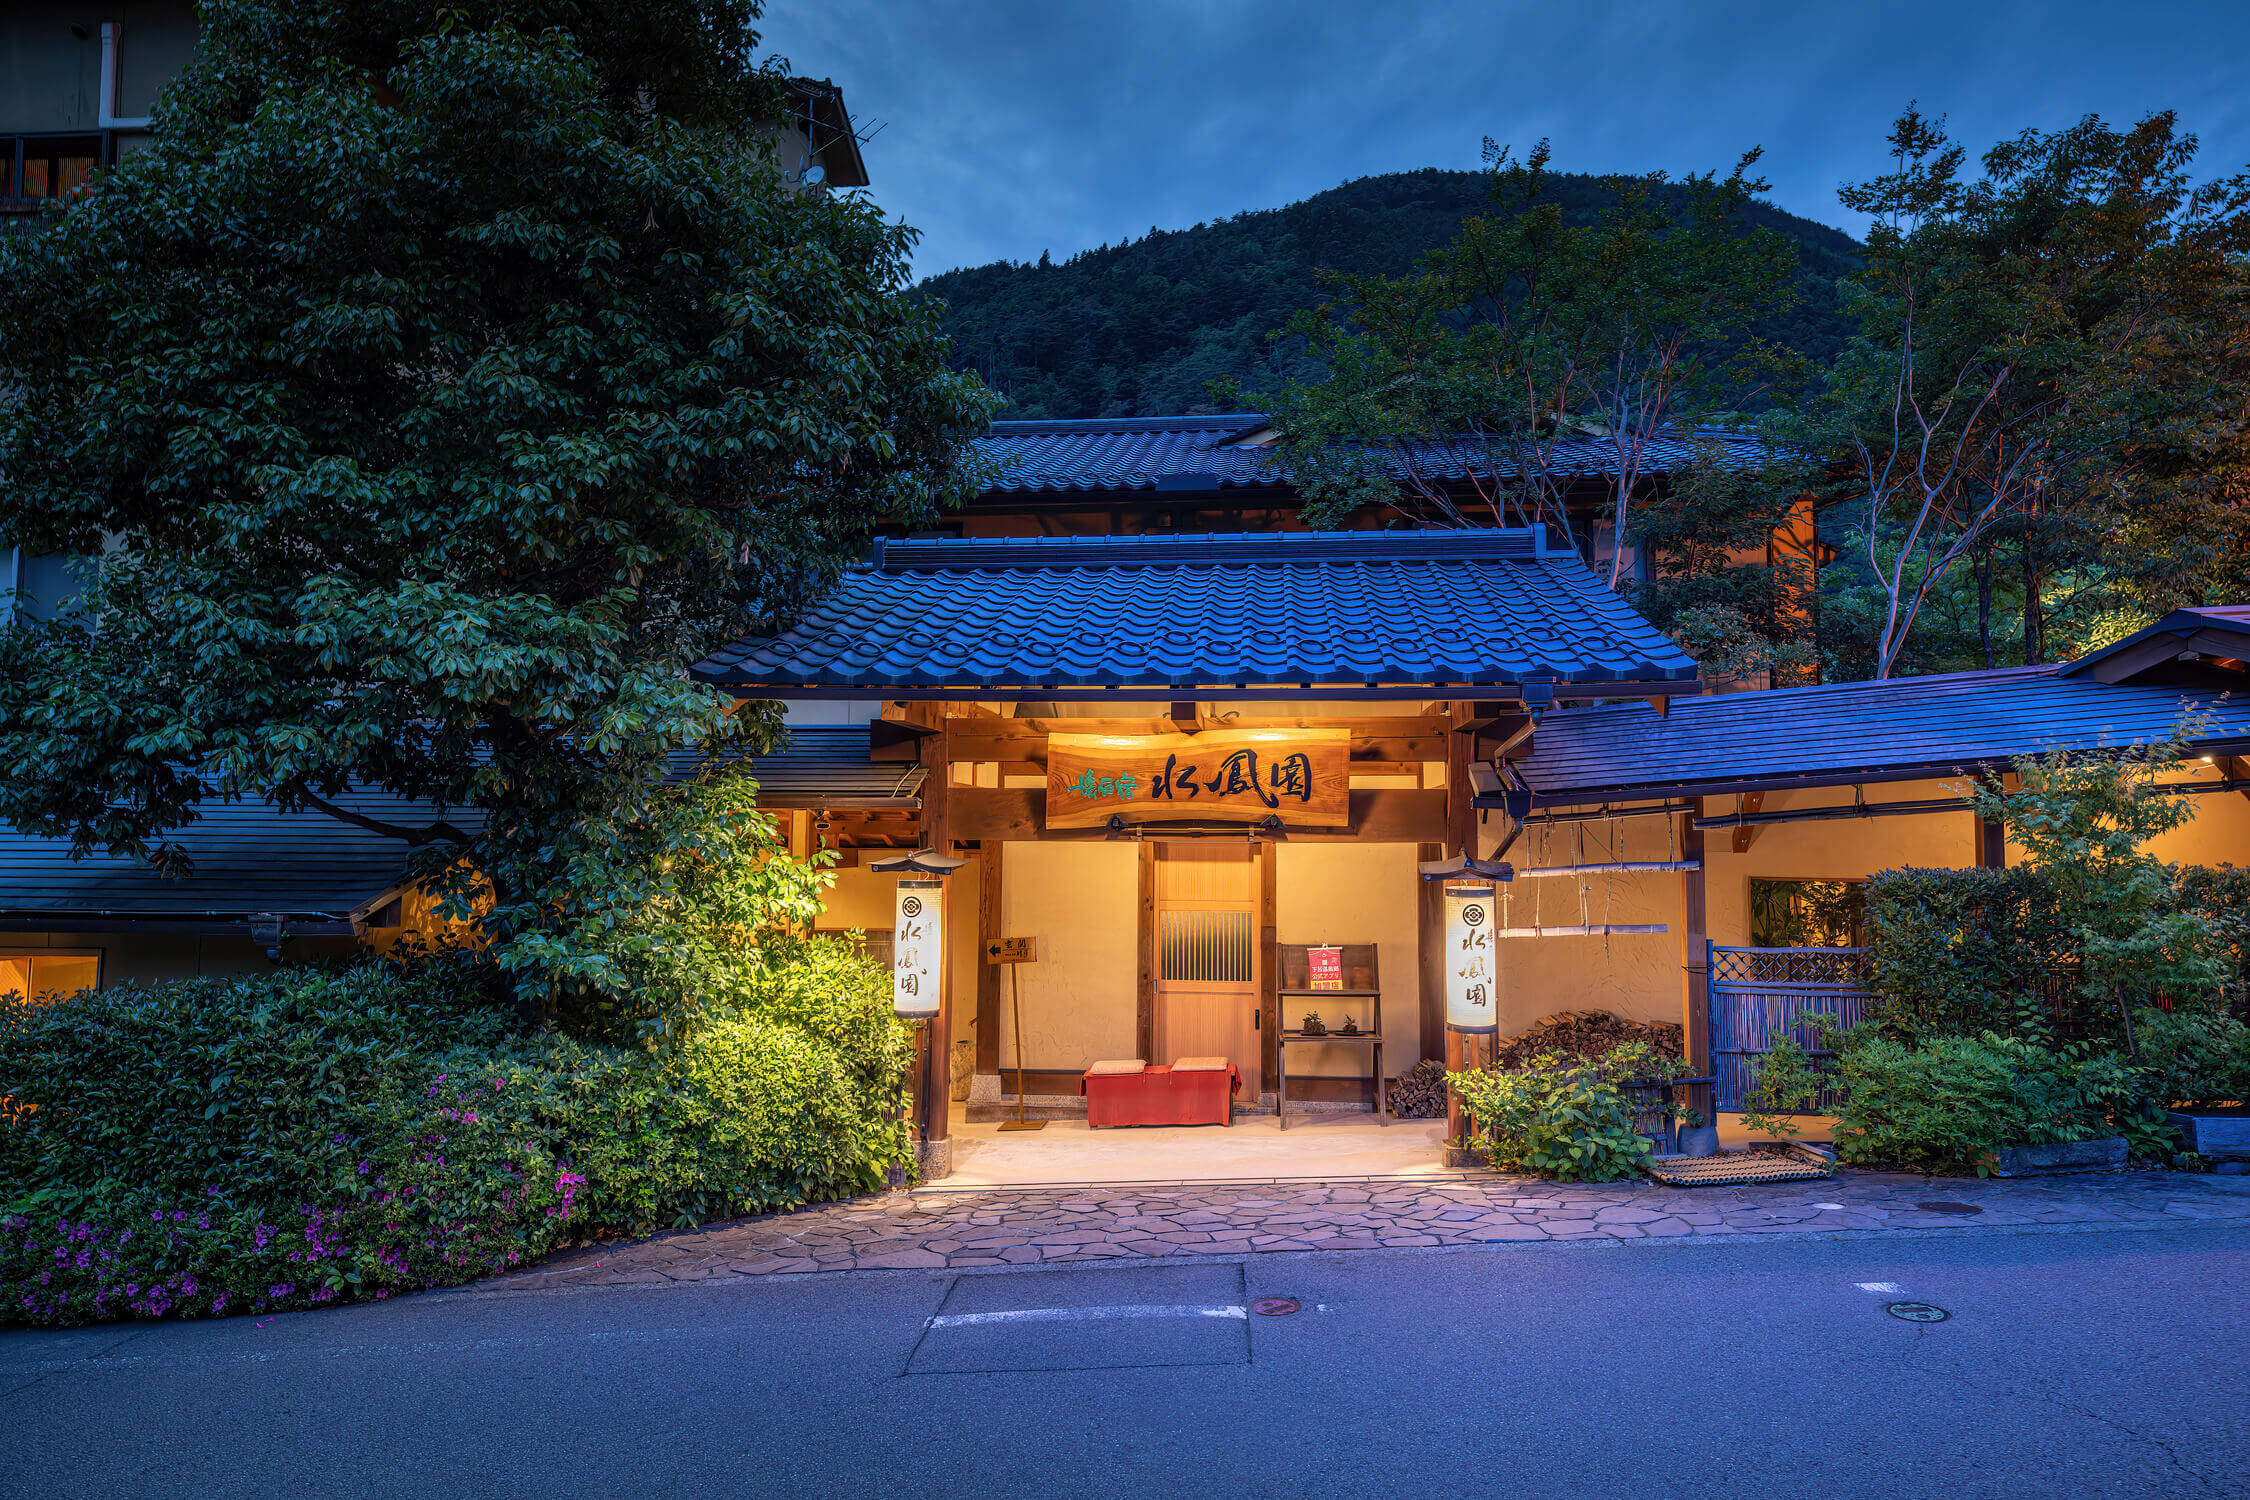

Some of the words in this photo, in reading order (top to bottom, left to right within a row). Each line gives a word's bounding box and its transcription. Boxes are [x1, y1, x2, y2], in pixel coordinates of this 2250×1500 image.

[1151, 748, 1312, 809] 水鳳園
[898, 920, 927, 996] 水鳳園
[1458, 928, 1492, 1007] 水鳳園
